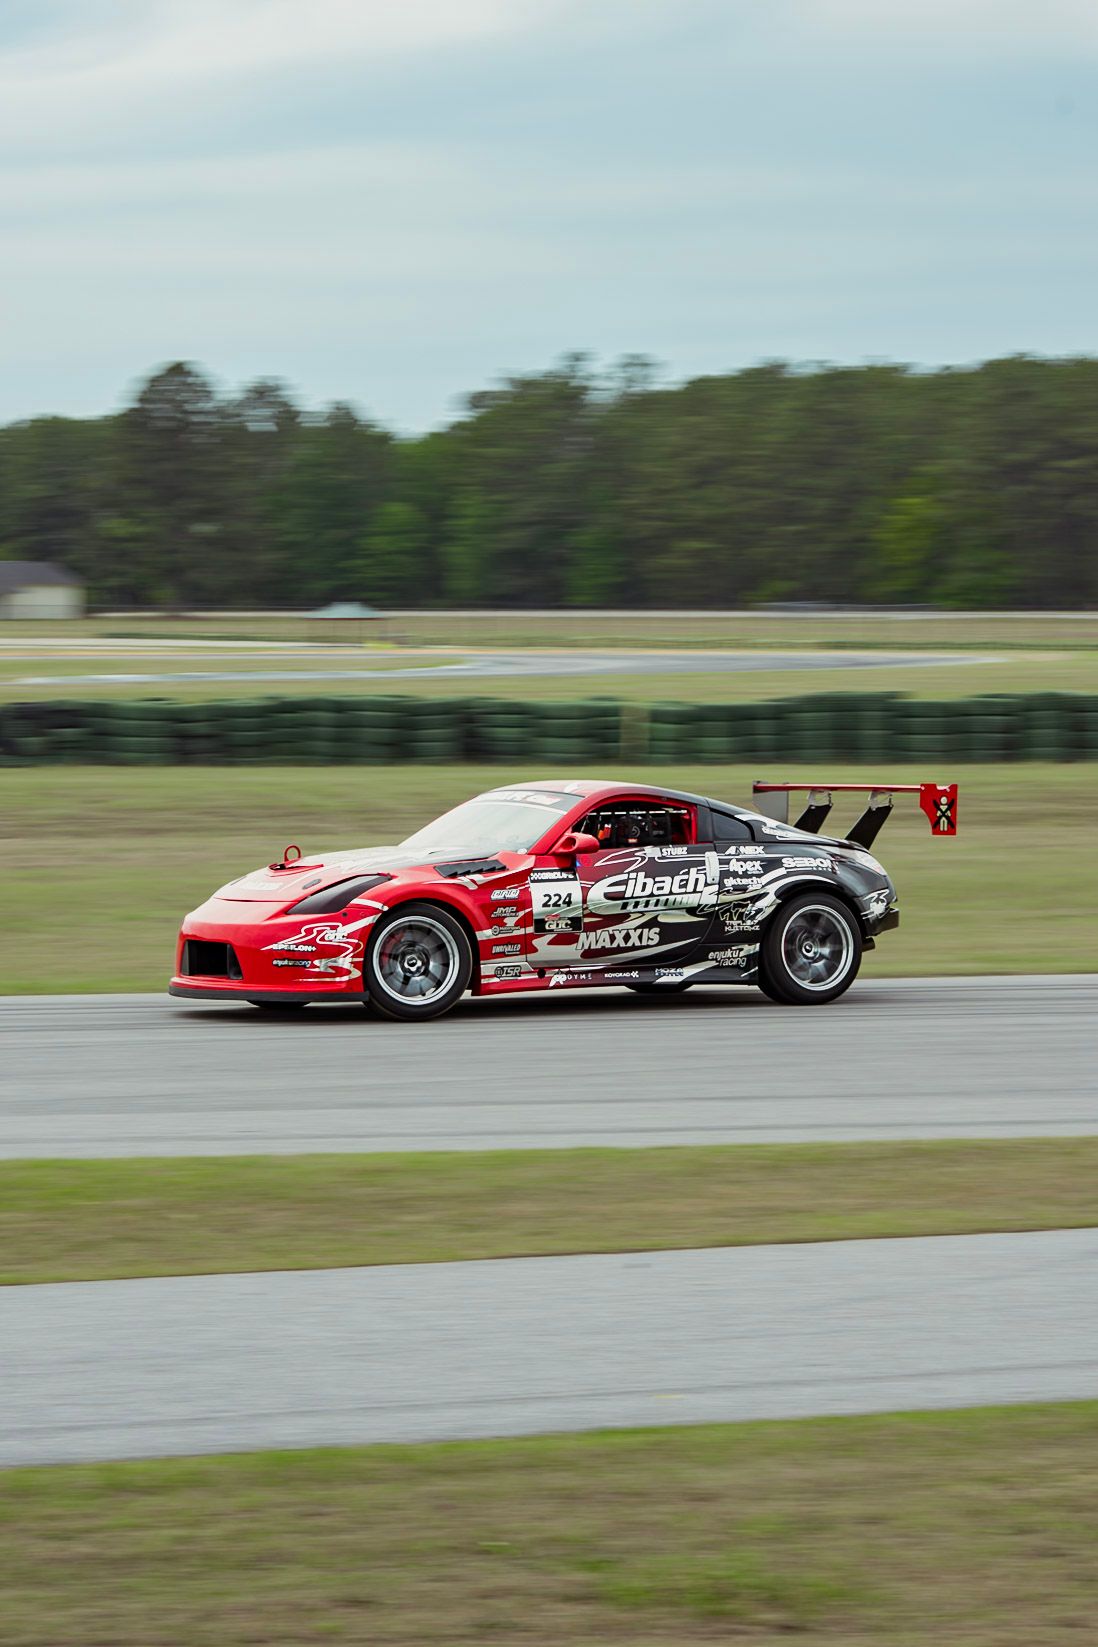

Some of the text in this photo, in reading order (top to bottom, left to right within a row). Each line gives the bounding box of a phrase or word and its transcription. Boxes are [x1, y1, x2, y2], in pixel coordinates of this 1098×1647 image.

[587, 868, 706, 912] Eibach
[541, 892, 573, 908] 224
[575, 928, 661, 951] MAXXIS
[708, 948, 740, 961] enjuku
[719, 956, 747, 968] racing
[502, 967, 521, 977] ISR
